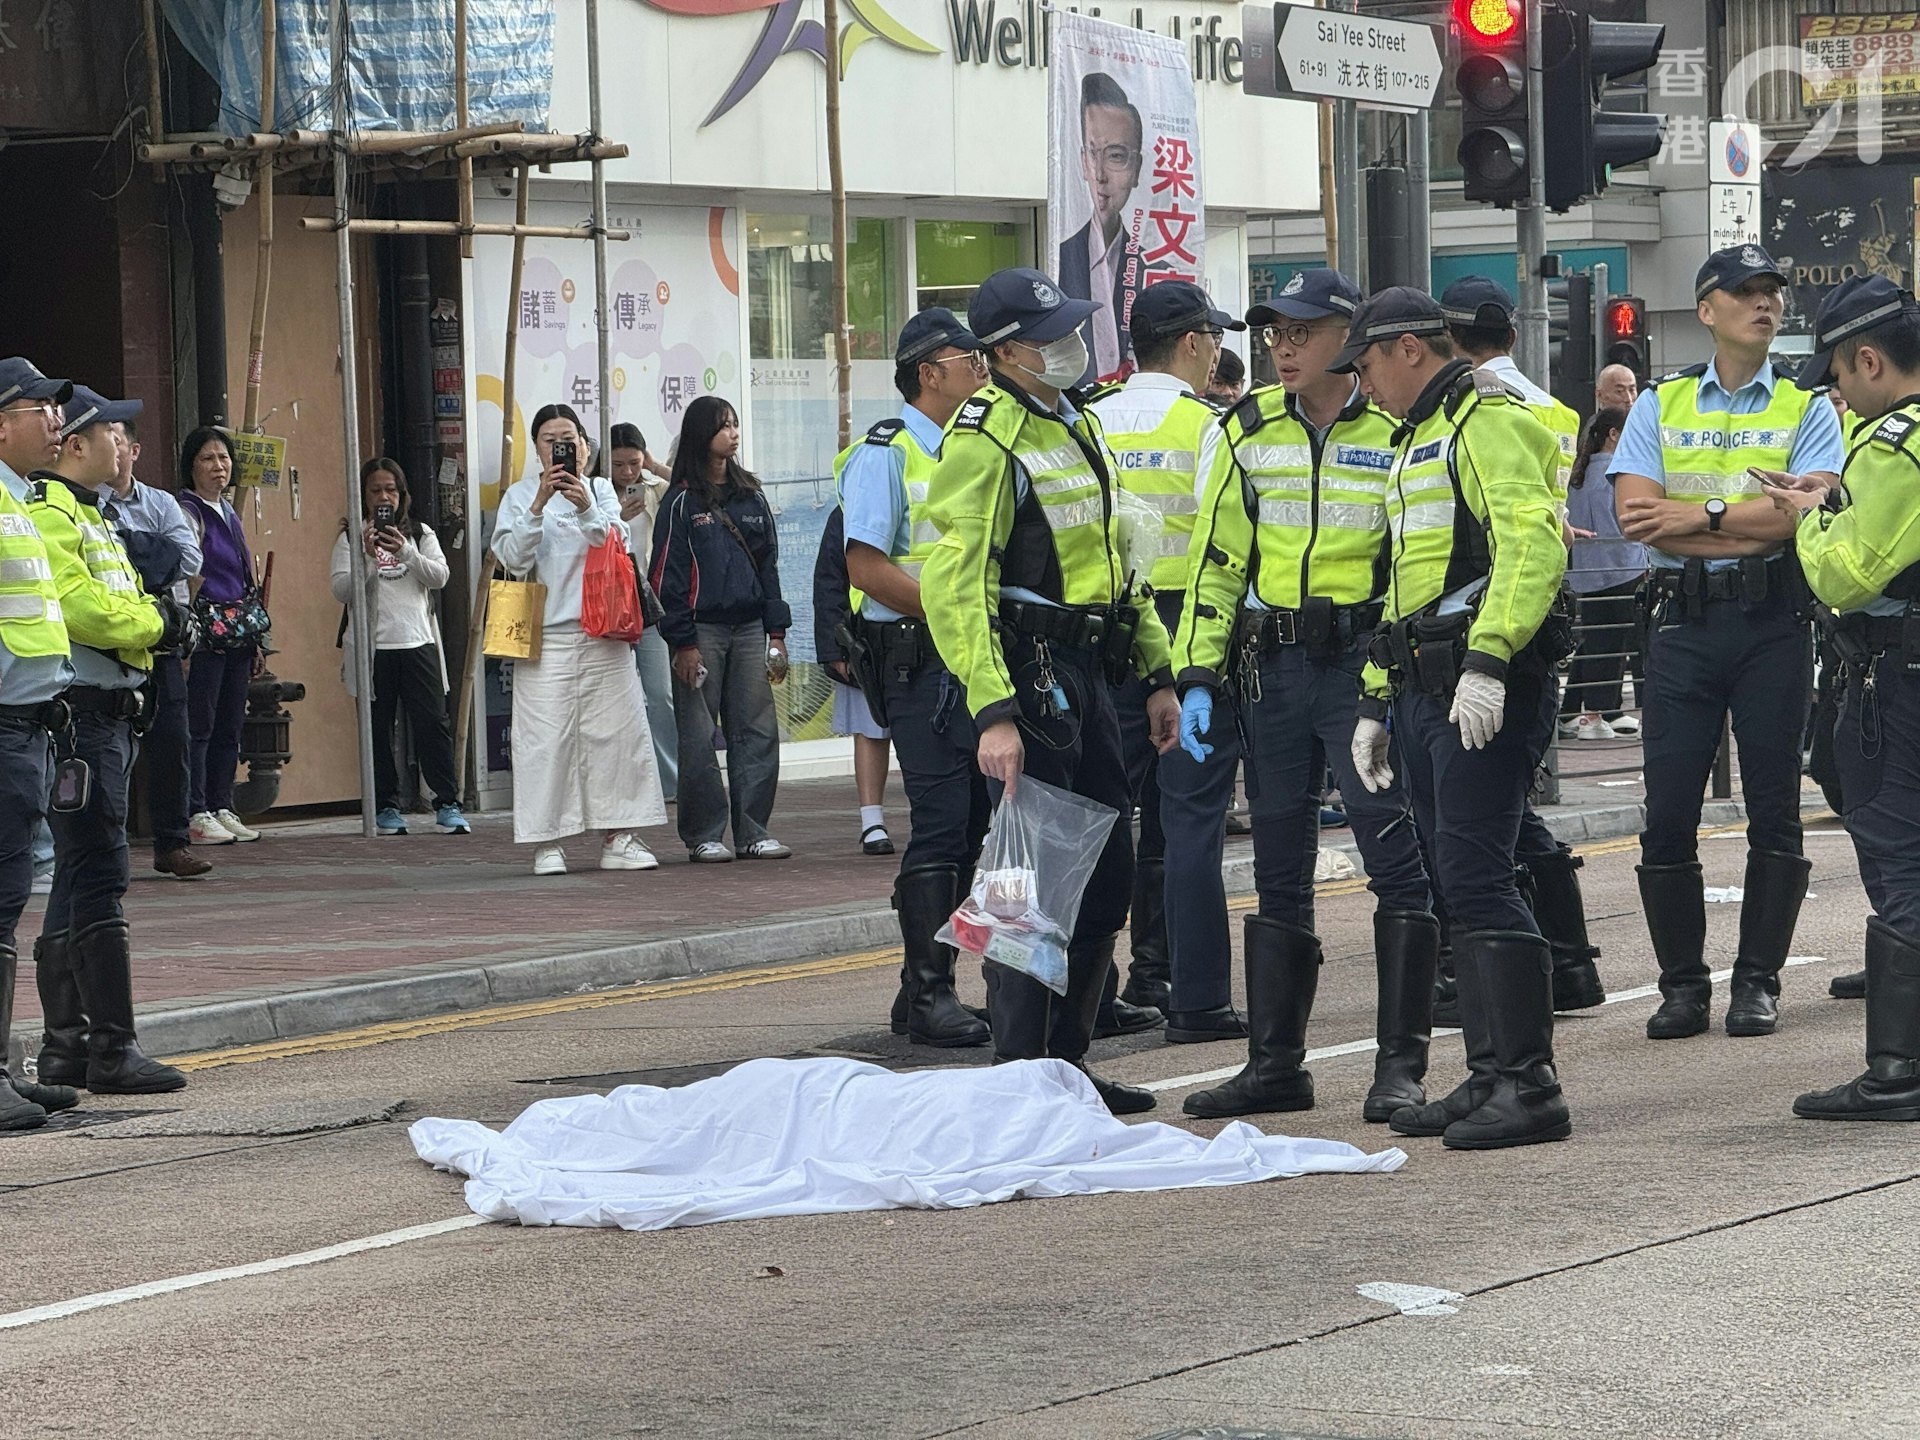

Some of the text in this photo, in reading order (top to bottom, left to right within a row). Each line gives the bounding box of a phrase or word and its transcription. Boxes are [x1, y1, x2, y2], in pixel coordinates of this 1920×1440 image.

[1317, 20, 1406, 53] Sai Yee Street
[1805, 33, 1914, 55] 趙先生 6889
[1337, 58, 1387, 91] 洗衣街
[1720, 199, 1737, 214] 上午
[1723, 188, 1753, 215] am 7
[1713, 229, 1744, 241] midnight
[1122, 208, 1144, 332] Leung Man Kwong
[1795, 264, 1858, 286] POLO
[519, 290, 557, 329] 儲蓄
[613, 292, 651, 330] 傳承
[543, 320, 566, 331] Savings
[638, 322, 657, 332] Legacy
[660, 375, 697, 414] 保障
[1701, 430, 1752, 449] POLICE
[1350, 452, 1382, 467] POLICE
